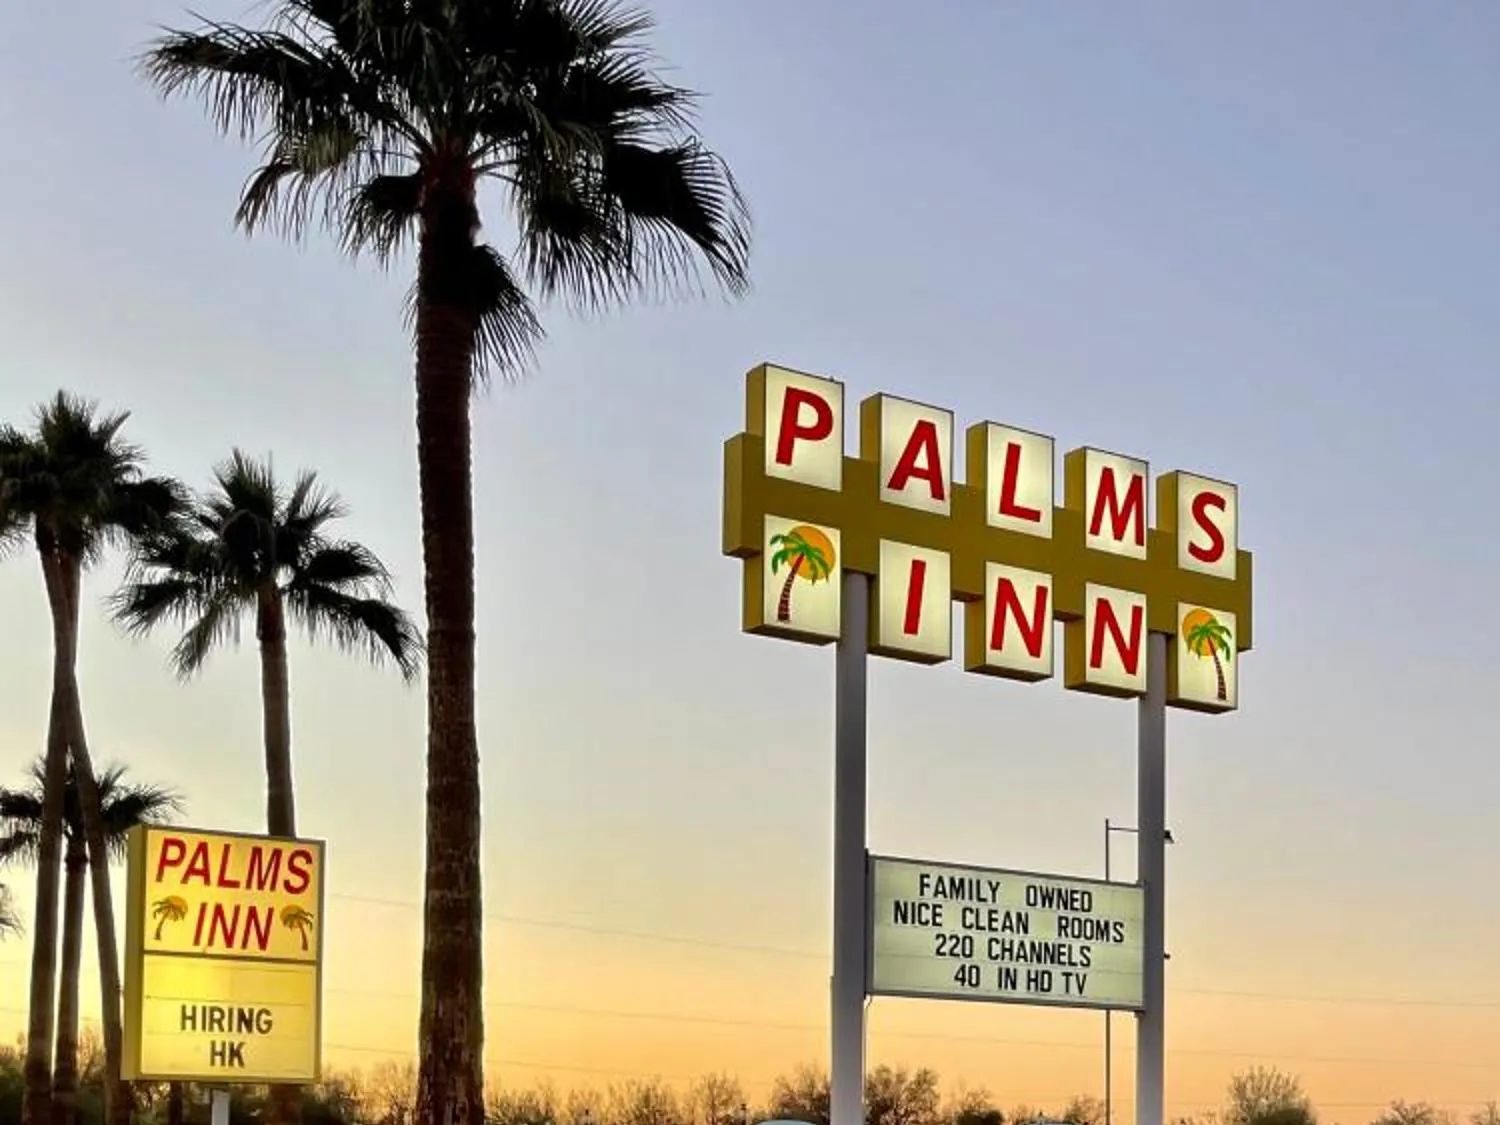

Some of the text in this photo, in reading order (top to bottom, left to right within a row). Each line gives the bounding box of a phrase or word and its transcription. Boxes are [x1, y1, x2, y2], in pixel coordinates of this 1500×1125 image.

[775, 385, 1227, 564] PALMS
[902, 560, 1144, 676] INN
[155, 837, 313, 895] PALMS
[919, 873, 1093, 913] FAMILY OWNED
[192, 902, 274, 951] INN
[893, 901, 1125, 943] NICE CLEAN ROOMS
[935, 933, 1091, 968] 220 CHANNELS
[954, 964, 1087, 995] 40 IN HD TV
[180, 1004, 273, 1035] HIRING
[209, 1040, 246, 1068] HK
